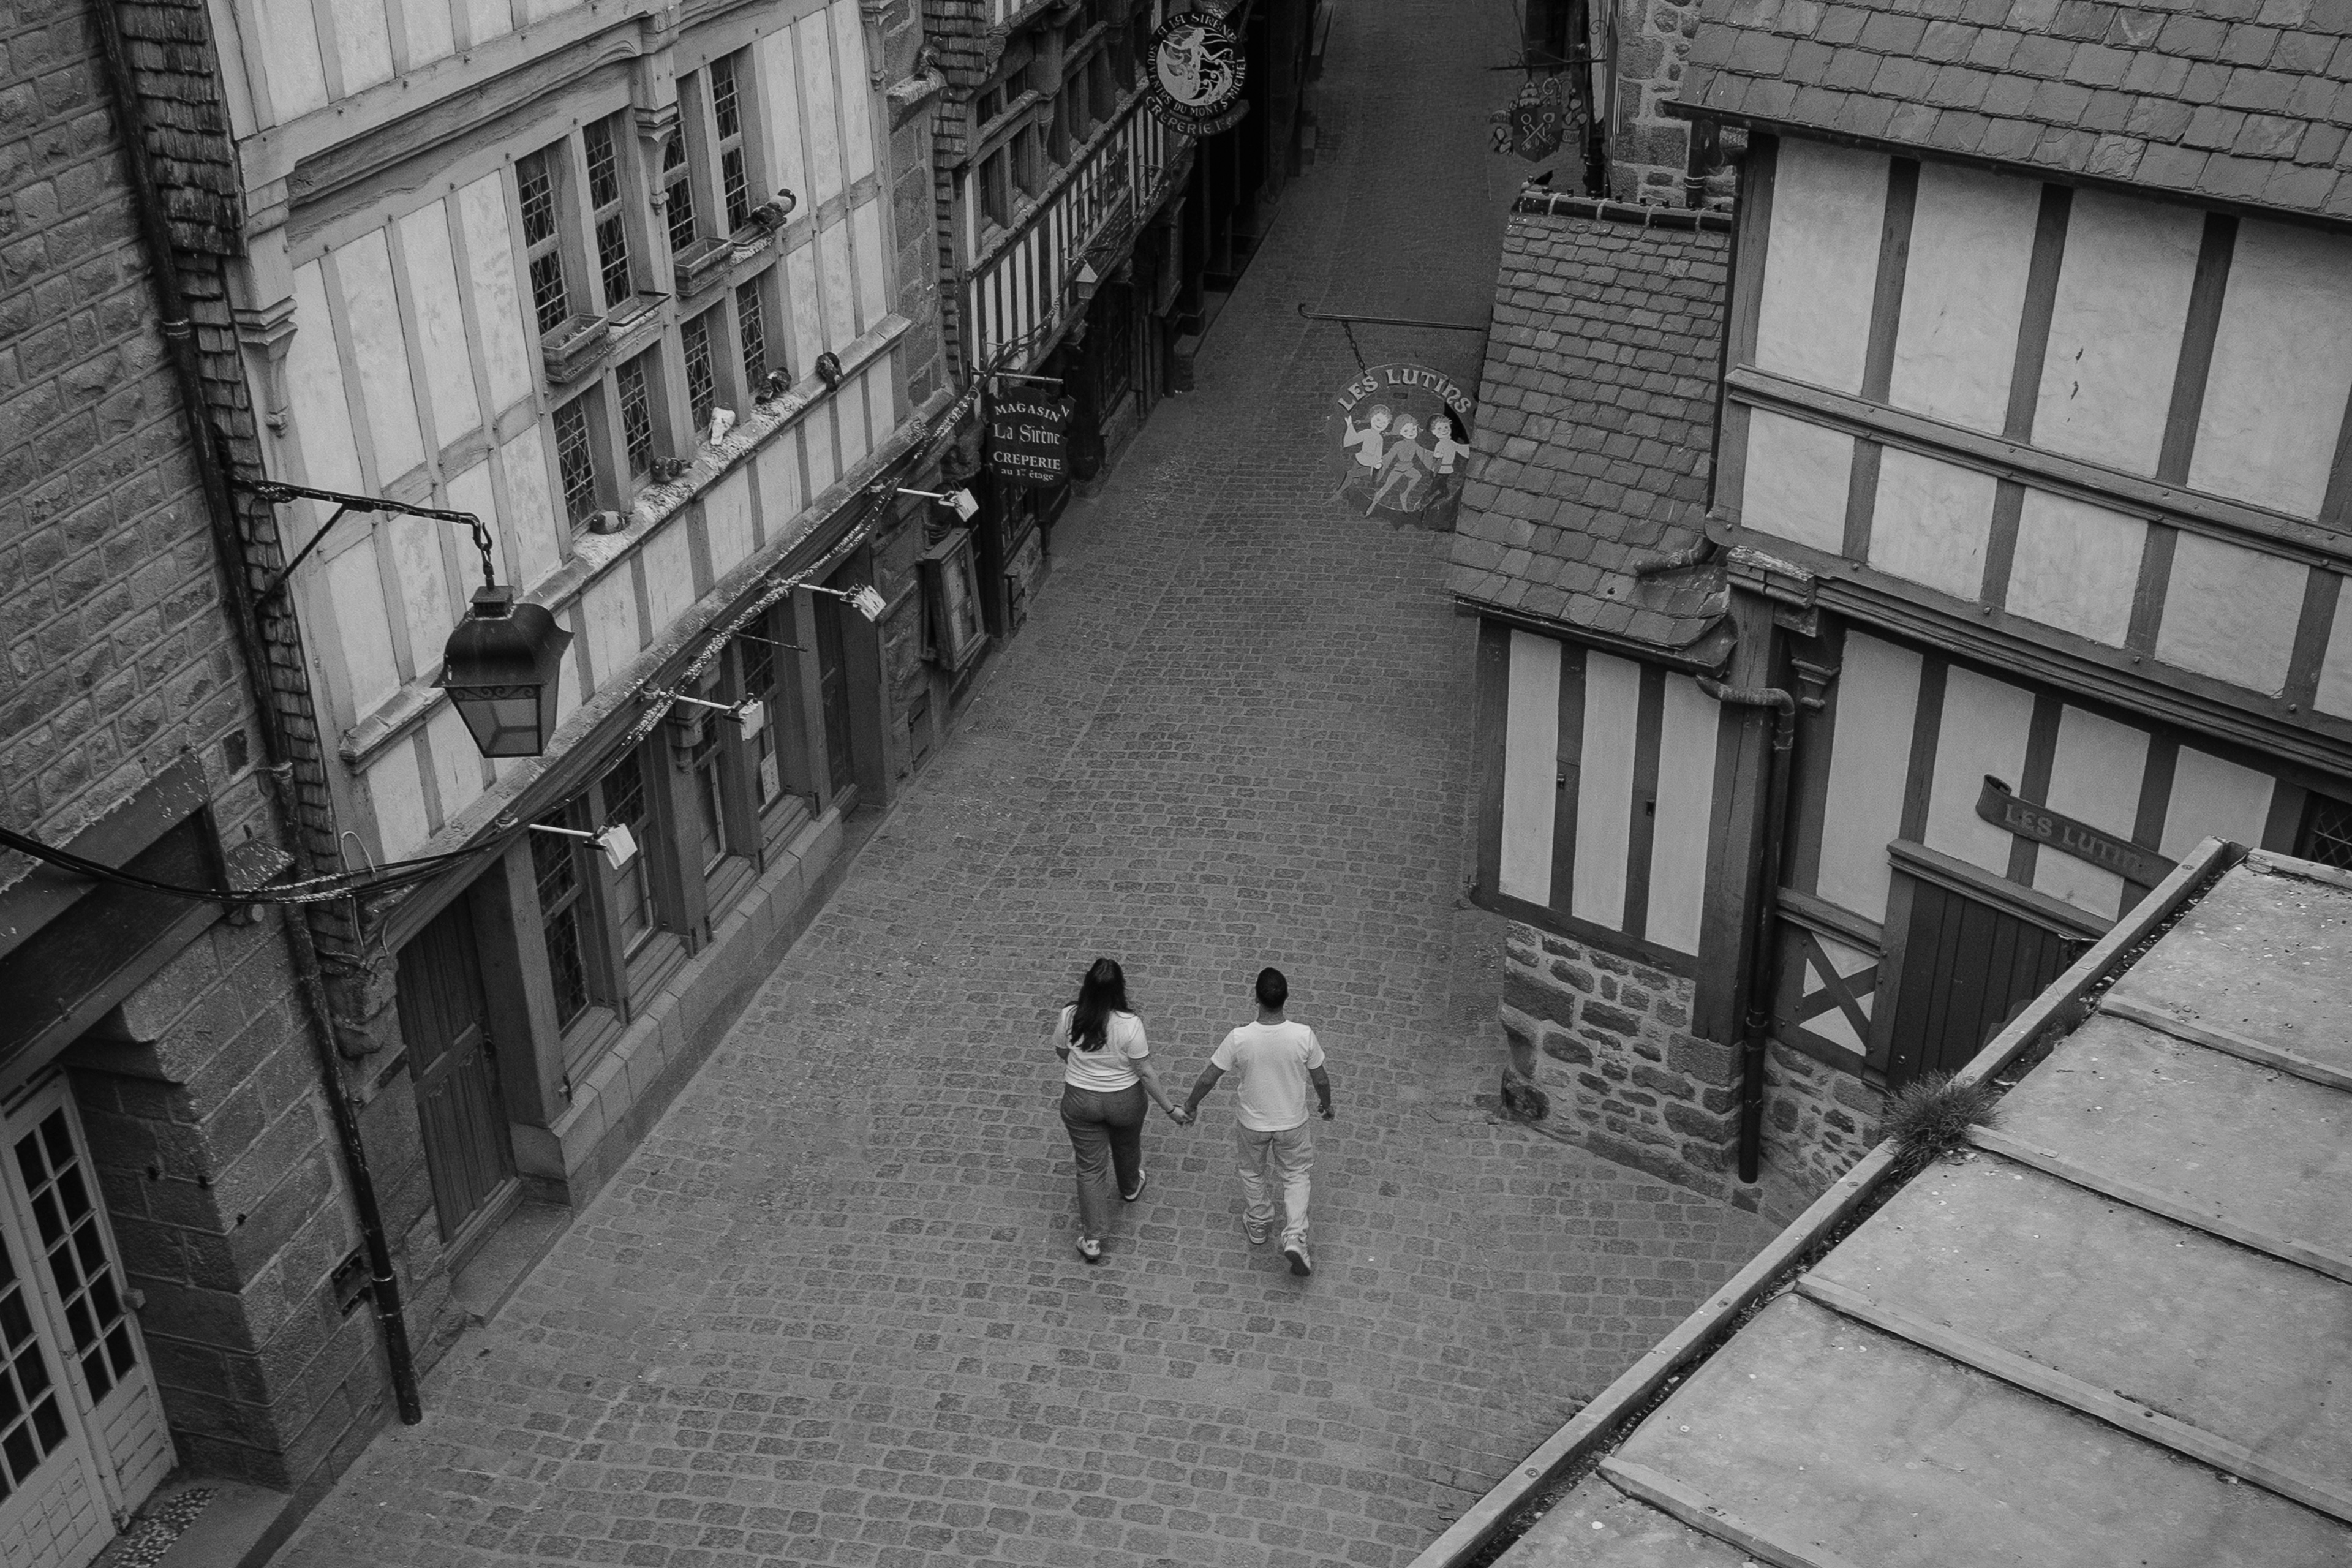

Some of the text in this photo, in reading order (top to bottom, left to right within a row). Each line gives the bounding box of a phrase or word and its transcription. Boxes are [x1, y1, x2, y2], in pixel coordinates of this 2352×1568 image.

[1169, 15, 1185, 28] LA
[1191, 13, 1237, 43] SIRENE
[1147, 43, 1172, 105] SOUVENIRS
[1174, 102, 1187, 114] DU
[1190, 106, 1218, 116] MONT
[1227, 56, 1246, 99] MICHEL
[1145, 96, 1212, 134] CREPERIE
[1338, 368, 1471, 413] LES LUTINS
[994, 402, 1061, 423] MAGASIN
[992, 423, 1060, 445] La Sirène
[993, 451, 1061, 470] CREPERIE
[1029, 470, 1054, 482] étage
[2003, 803, 2052, 837] LES
